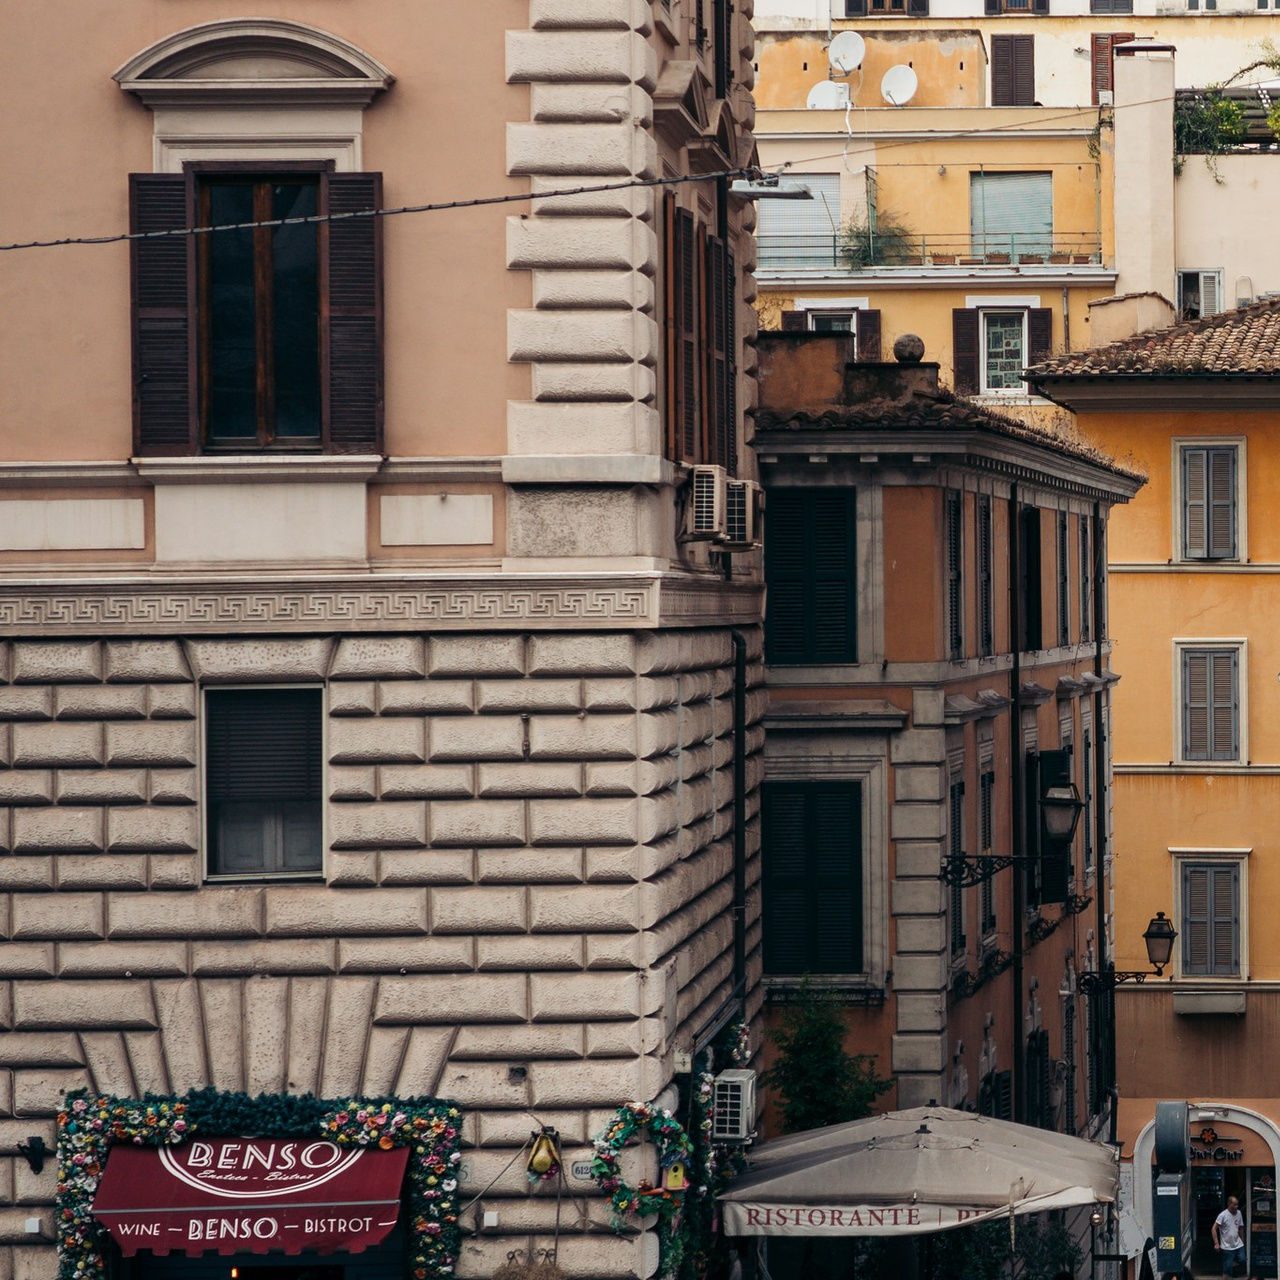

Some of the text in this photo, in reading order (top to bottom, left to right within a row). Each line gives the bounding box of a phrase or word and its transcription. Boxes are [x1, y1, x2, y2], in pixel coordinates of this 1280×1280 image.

[187, 1141, 342, 1170] BENSO
[196, 1170, 313, 1181] Enoteca Bistrot
[575, 1166, 592, 1175] 612
[746, 1208, 994, 1227] RISTORANTE PI
[118, 1217, 372, 1240] WINE BENSO BISTROT
